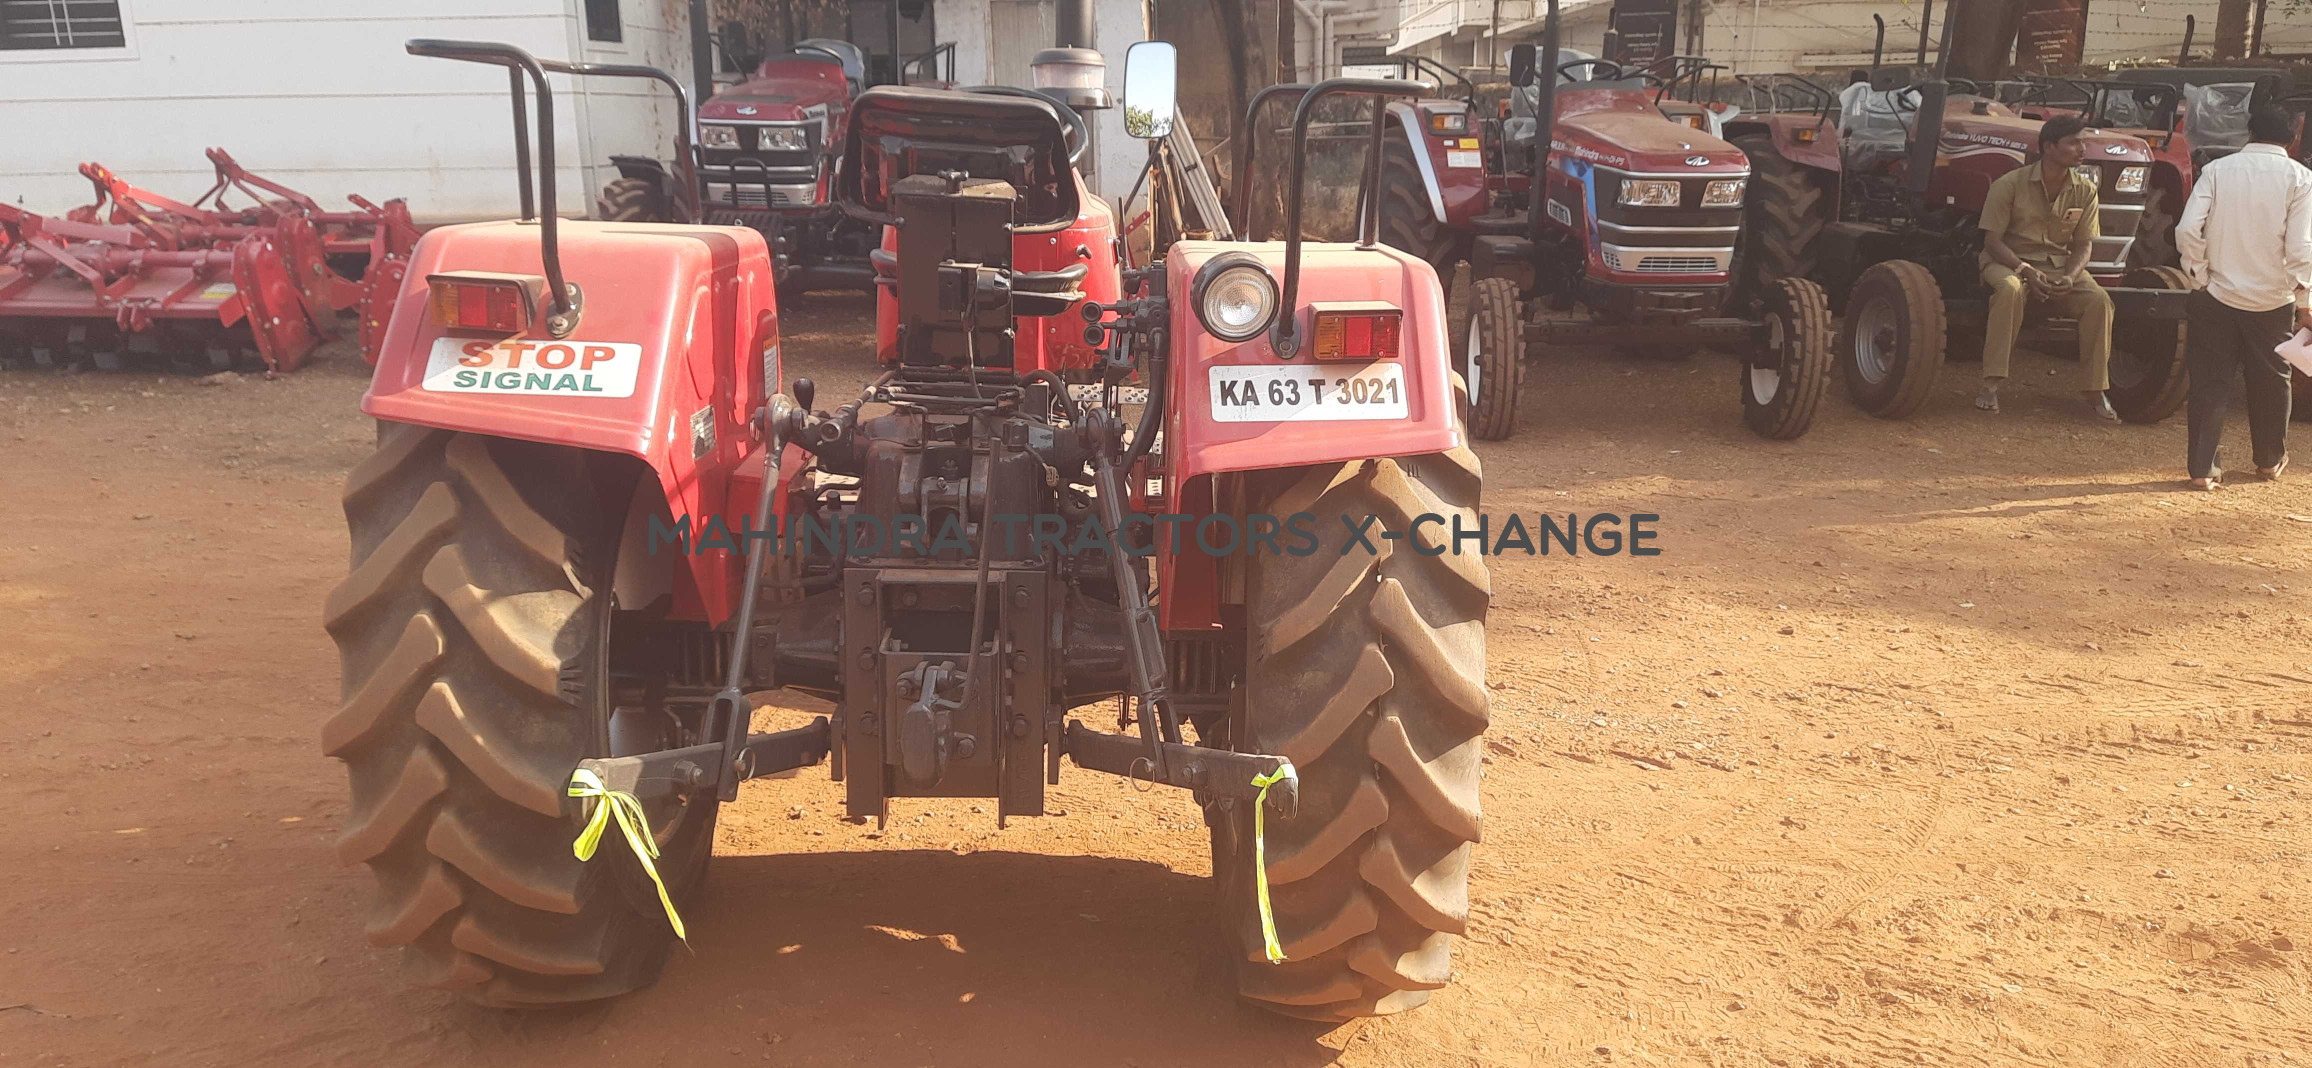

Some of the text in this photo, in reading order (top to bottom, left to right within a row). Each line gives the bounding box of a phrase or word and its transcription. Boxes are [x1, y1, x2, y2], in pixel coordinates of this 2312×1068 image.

[1988, 136, 2006, 146] TECH
[458, 341, 616, 371] STOP
[453, 370, 603, 392] SIGNAL
[1219, 377, 1399, 406] KA 63 T 3021
